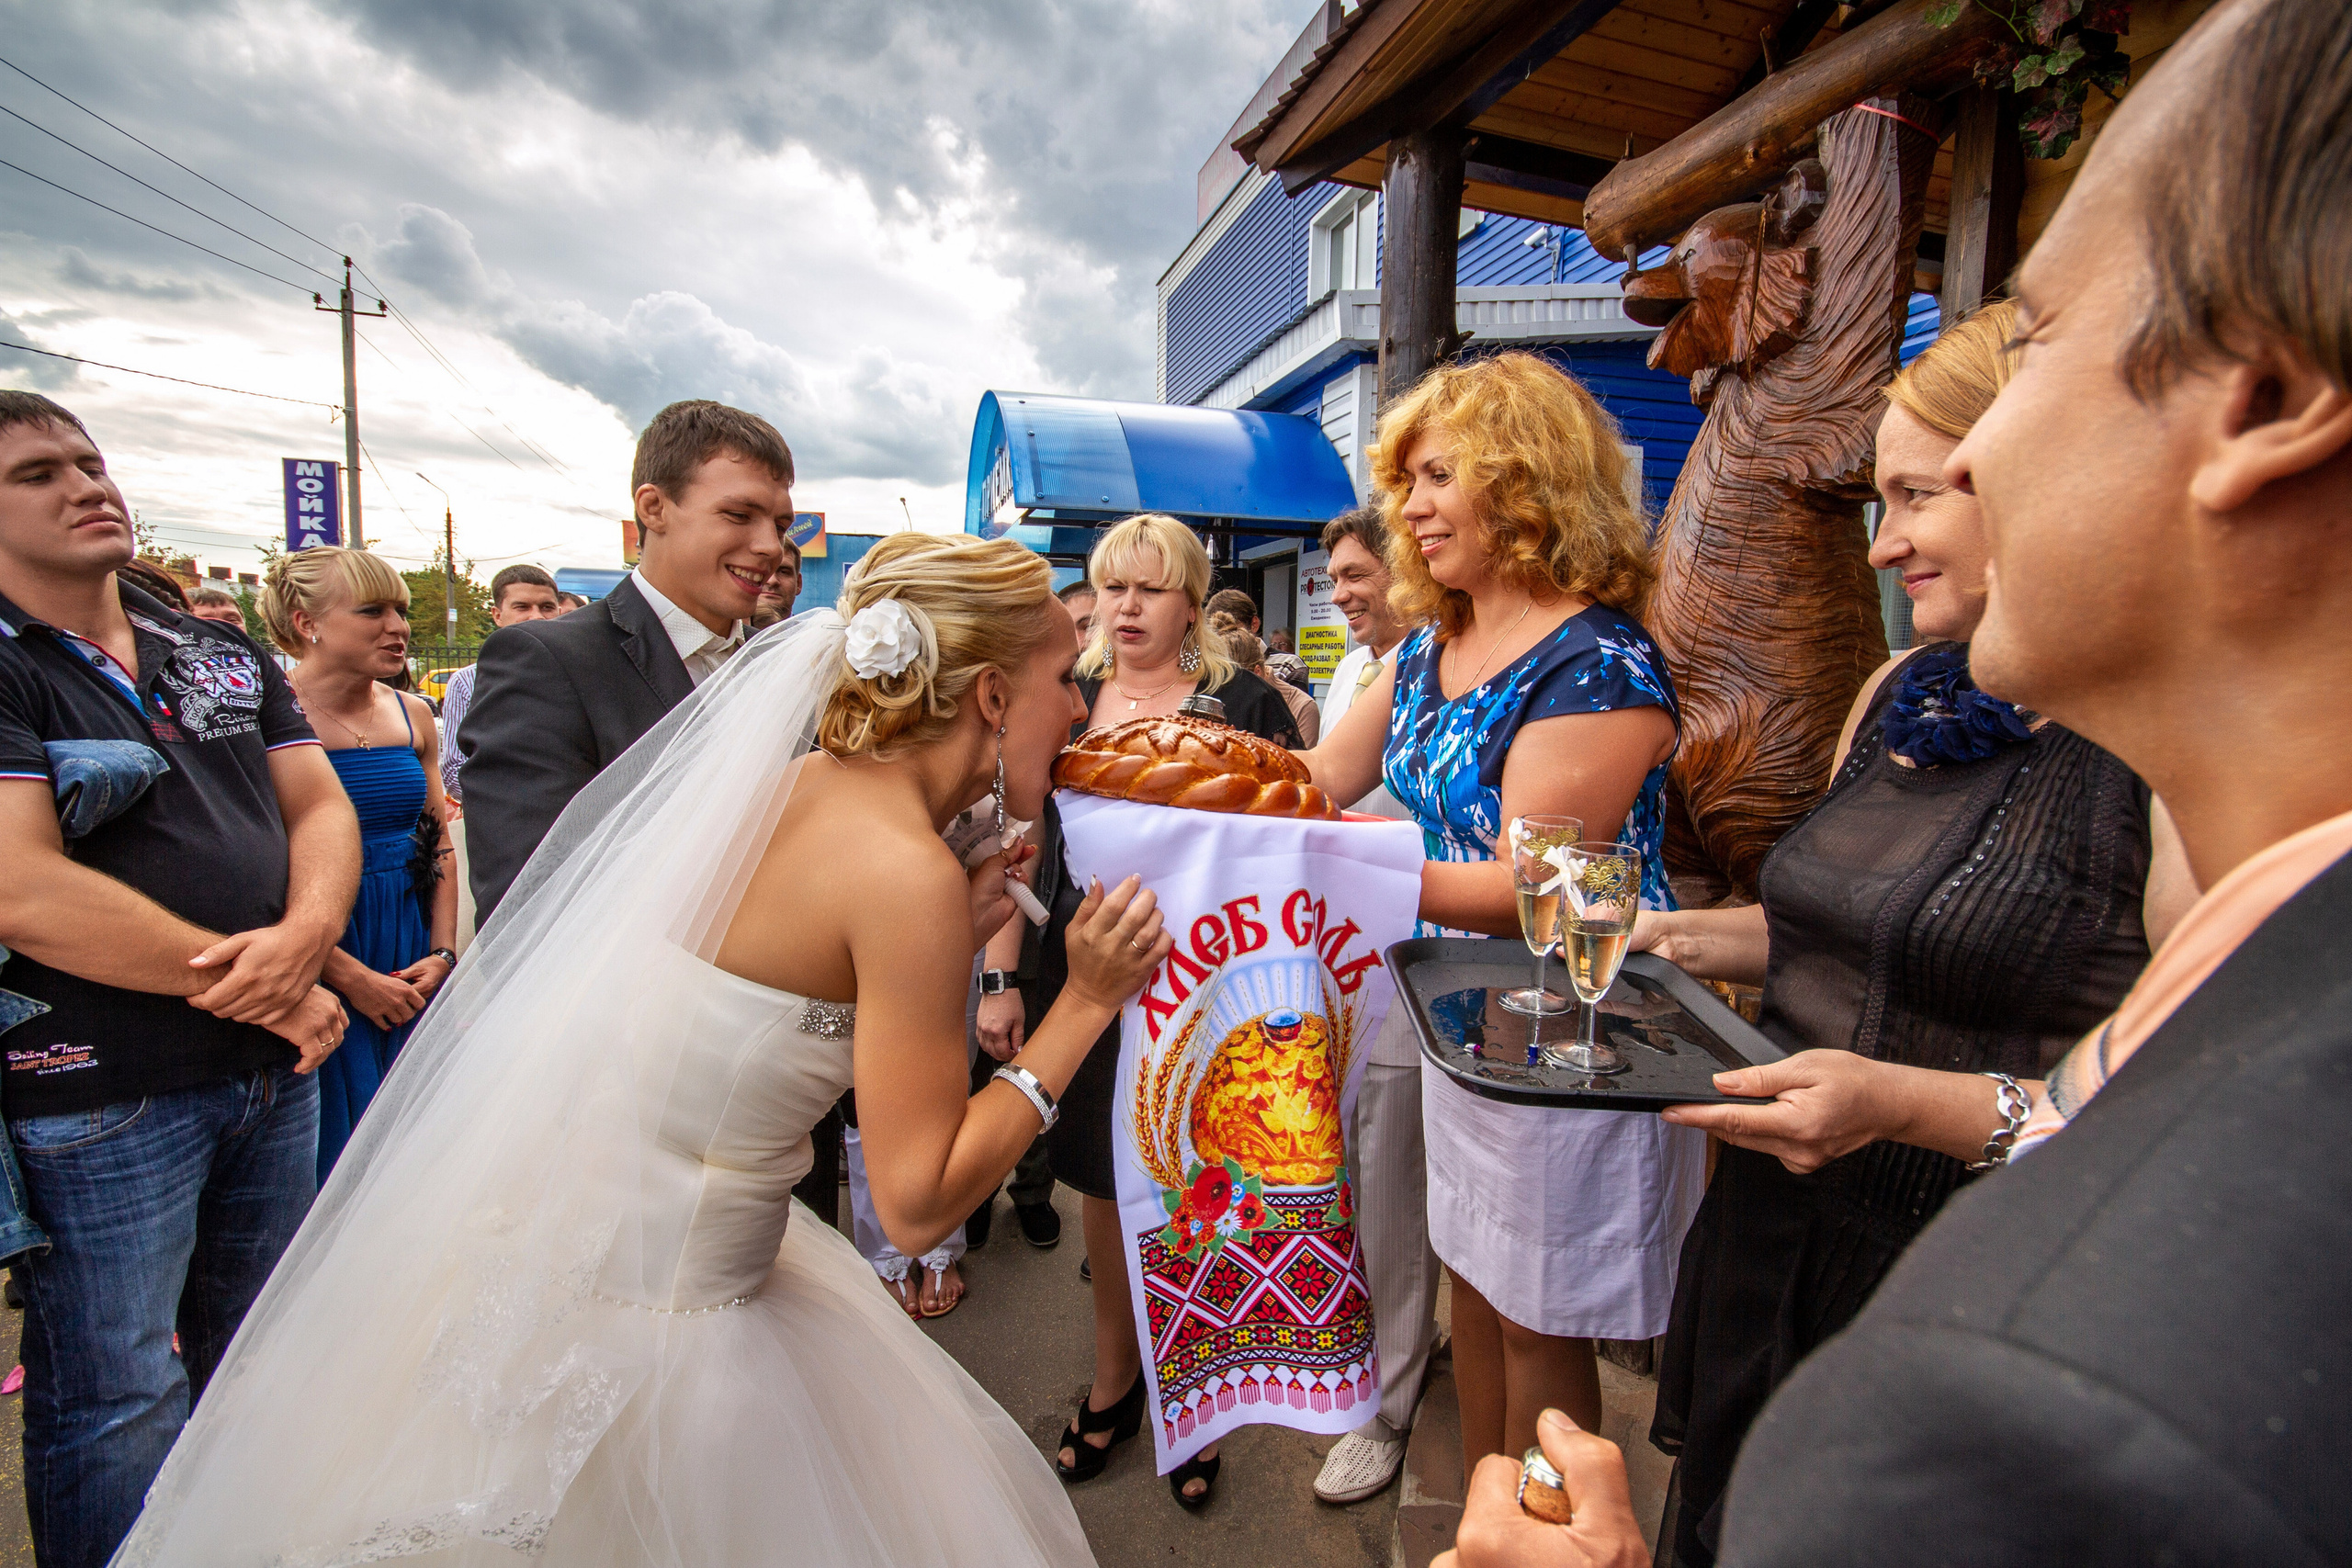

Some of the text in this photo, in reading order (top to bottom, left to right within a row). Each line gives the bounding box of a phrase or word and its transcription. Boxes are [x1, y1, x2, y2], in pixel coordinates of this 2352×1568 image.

[1283, 9, 1324, 90] КАЛЬЯН
[295, 461, 327, 547] МОЙКА
[1306, 630, 1338, 639] ДИАГНОСТИКА
[197, 724, 243, 742] PREIUM
[50, 1043, 94, 1054] Team
[10, 1052, 90, 1071] SAINT TROPEZ
